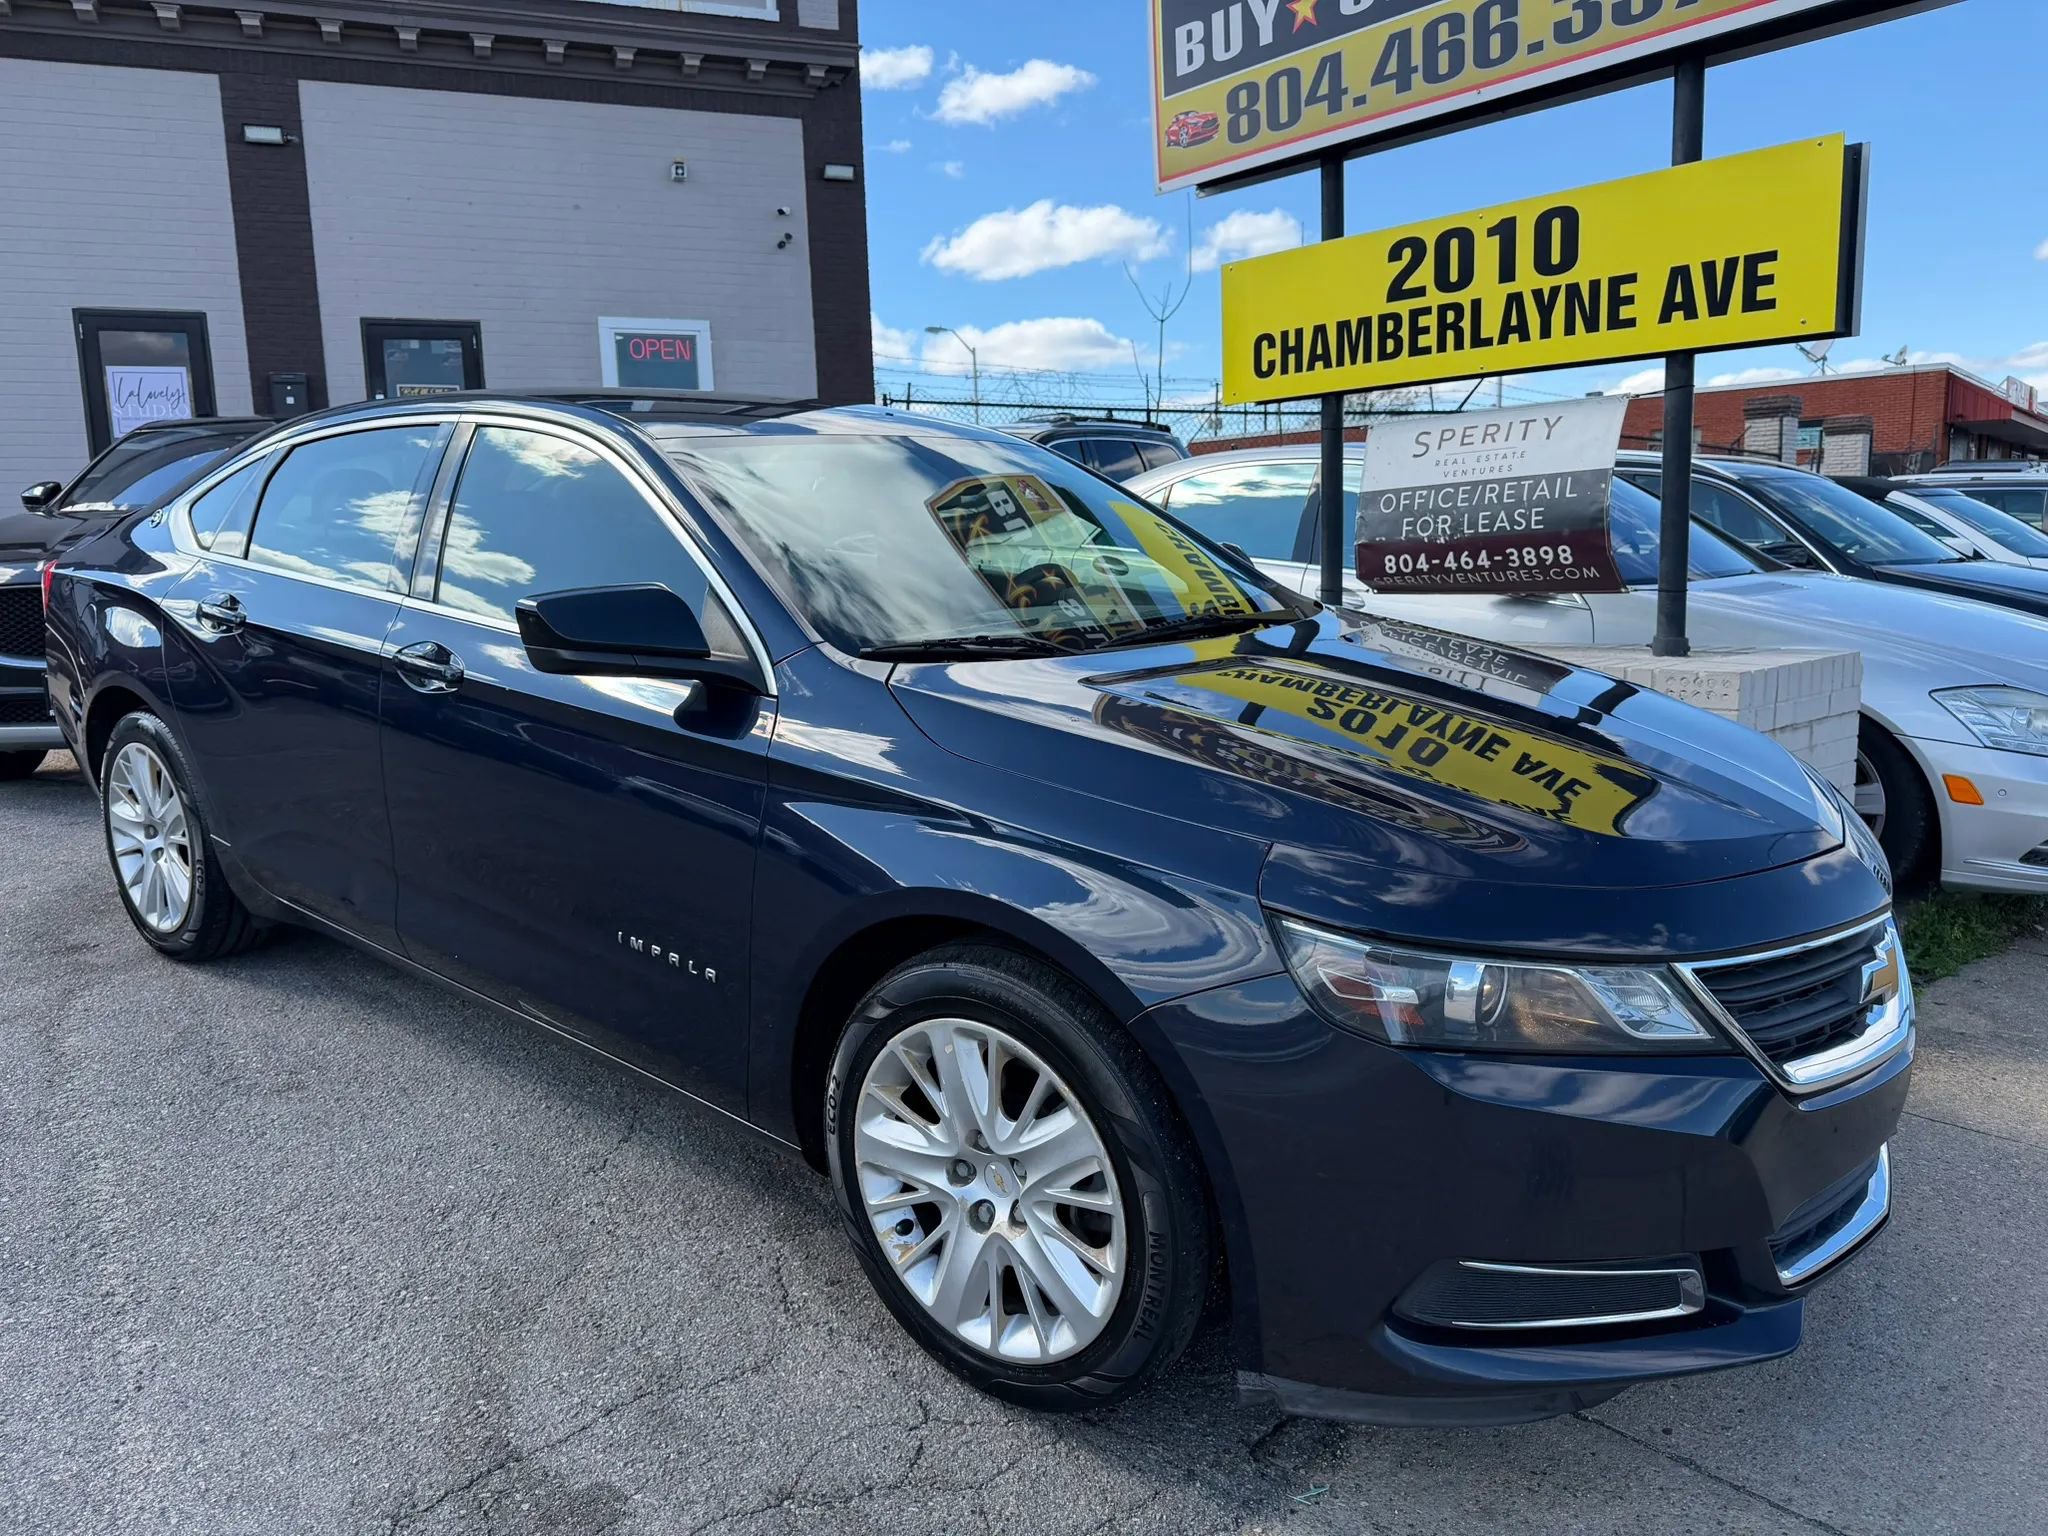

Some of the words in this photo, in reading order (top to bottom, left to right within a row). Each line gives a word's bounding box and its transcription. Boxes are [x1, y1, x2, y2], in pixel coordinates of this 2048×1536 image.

[1175, 0, 1280, 77] BUY
[1386, 205, 1581, 303] 2010
[1253, 272, 1638, 379] CHAMBERLAYNE
[1657, 249, 1779, 325] AVE
[629, 338, 691, 361] OPEN
[112, 404, 190, 418] STUDIO
[1411, 416, 1563, 458] SPERITY
[1434, 457, 1467, 467] REAL
[1476, 450, 1526, 463] ESTATE
[1443, 464, 1514, 478] VENTURES
[1379, 477, 1578, 513] OFFICE/RETAIL
[1401, 515, 1452, 538] FOR
[1463, 508, 1546, 534] LEASE
[1372, 566, 1601, 586] SPERITYVENTURES.COM
[1383, 545, 1574, 574] 804-464-3898
[617, 931, 717, 983] IMPALA
[1132, 1228, 1168, 1341] MONTREAL
